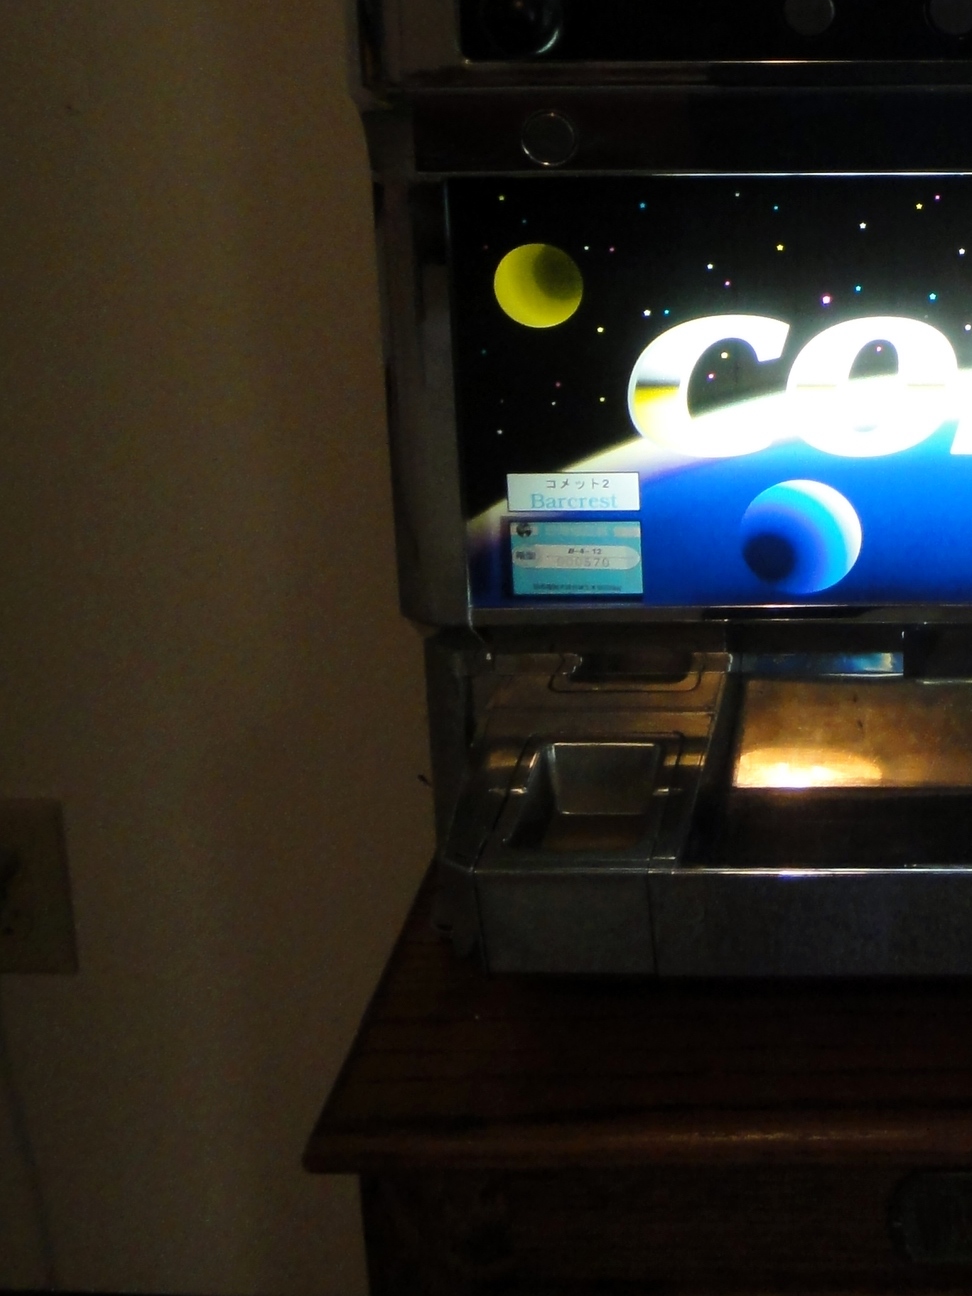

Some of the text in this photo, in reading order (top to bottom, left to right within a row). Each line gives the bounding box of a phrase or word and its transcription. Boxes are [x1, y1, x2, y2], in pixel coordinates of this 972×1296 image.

[546, 478, 610, 489] コメット2
[530, 492, 618, 510] Barcrest
